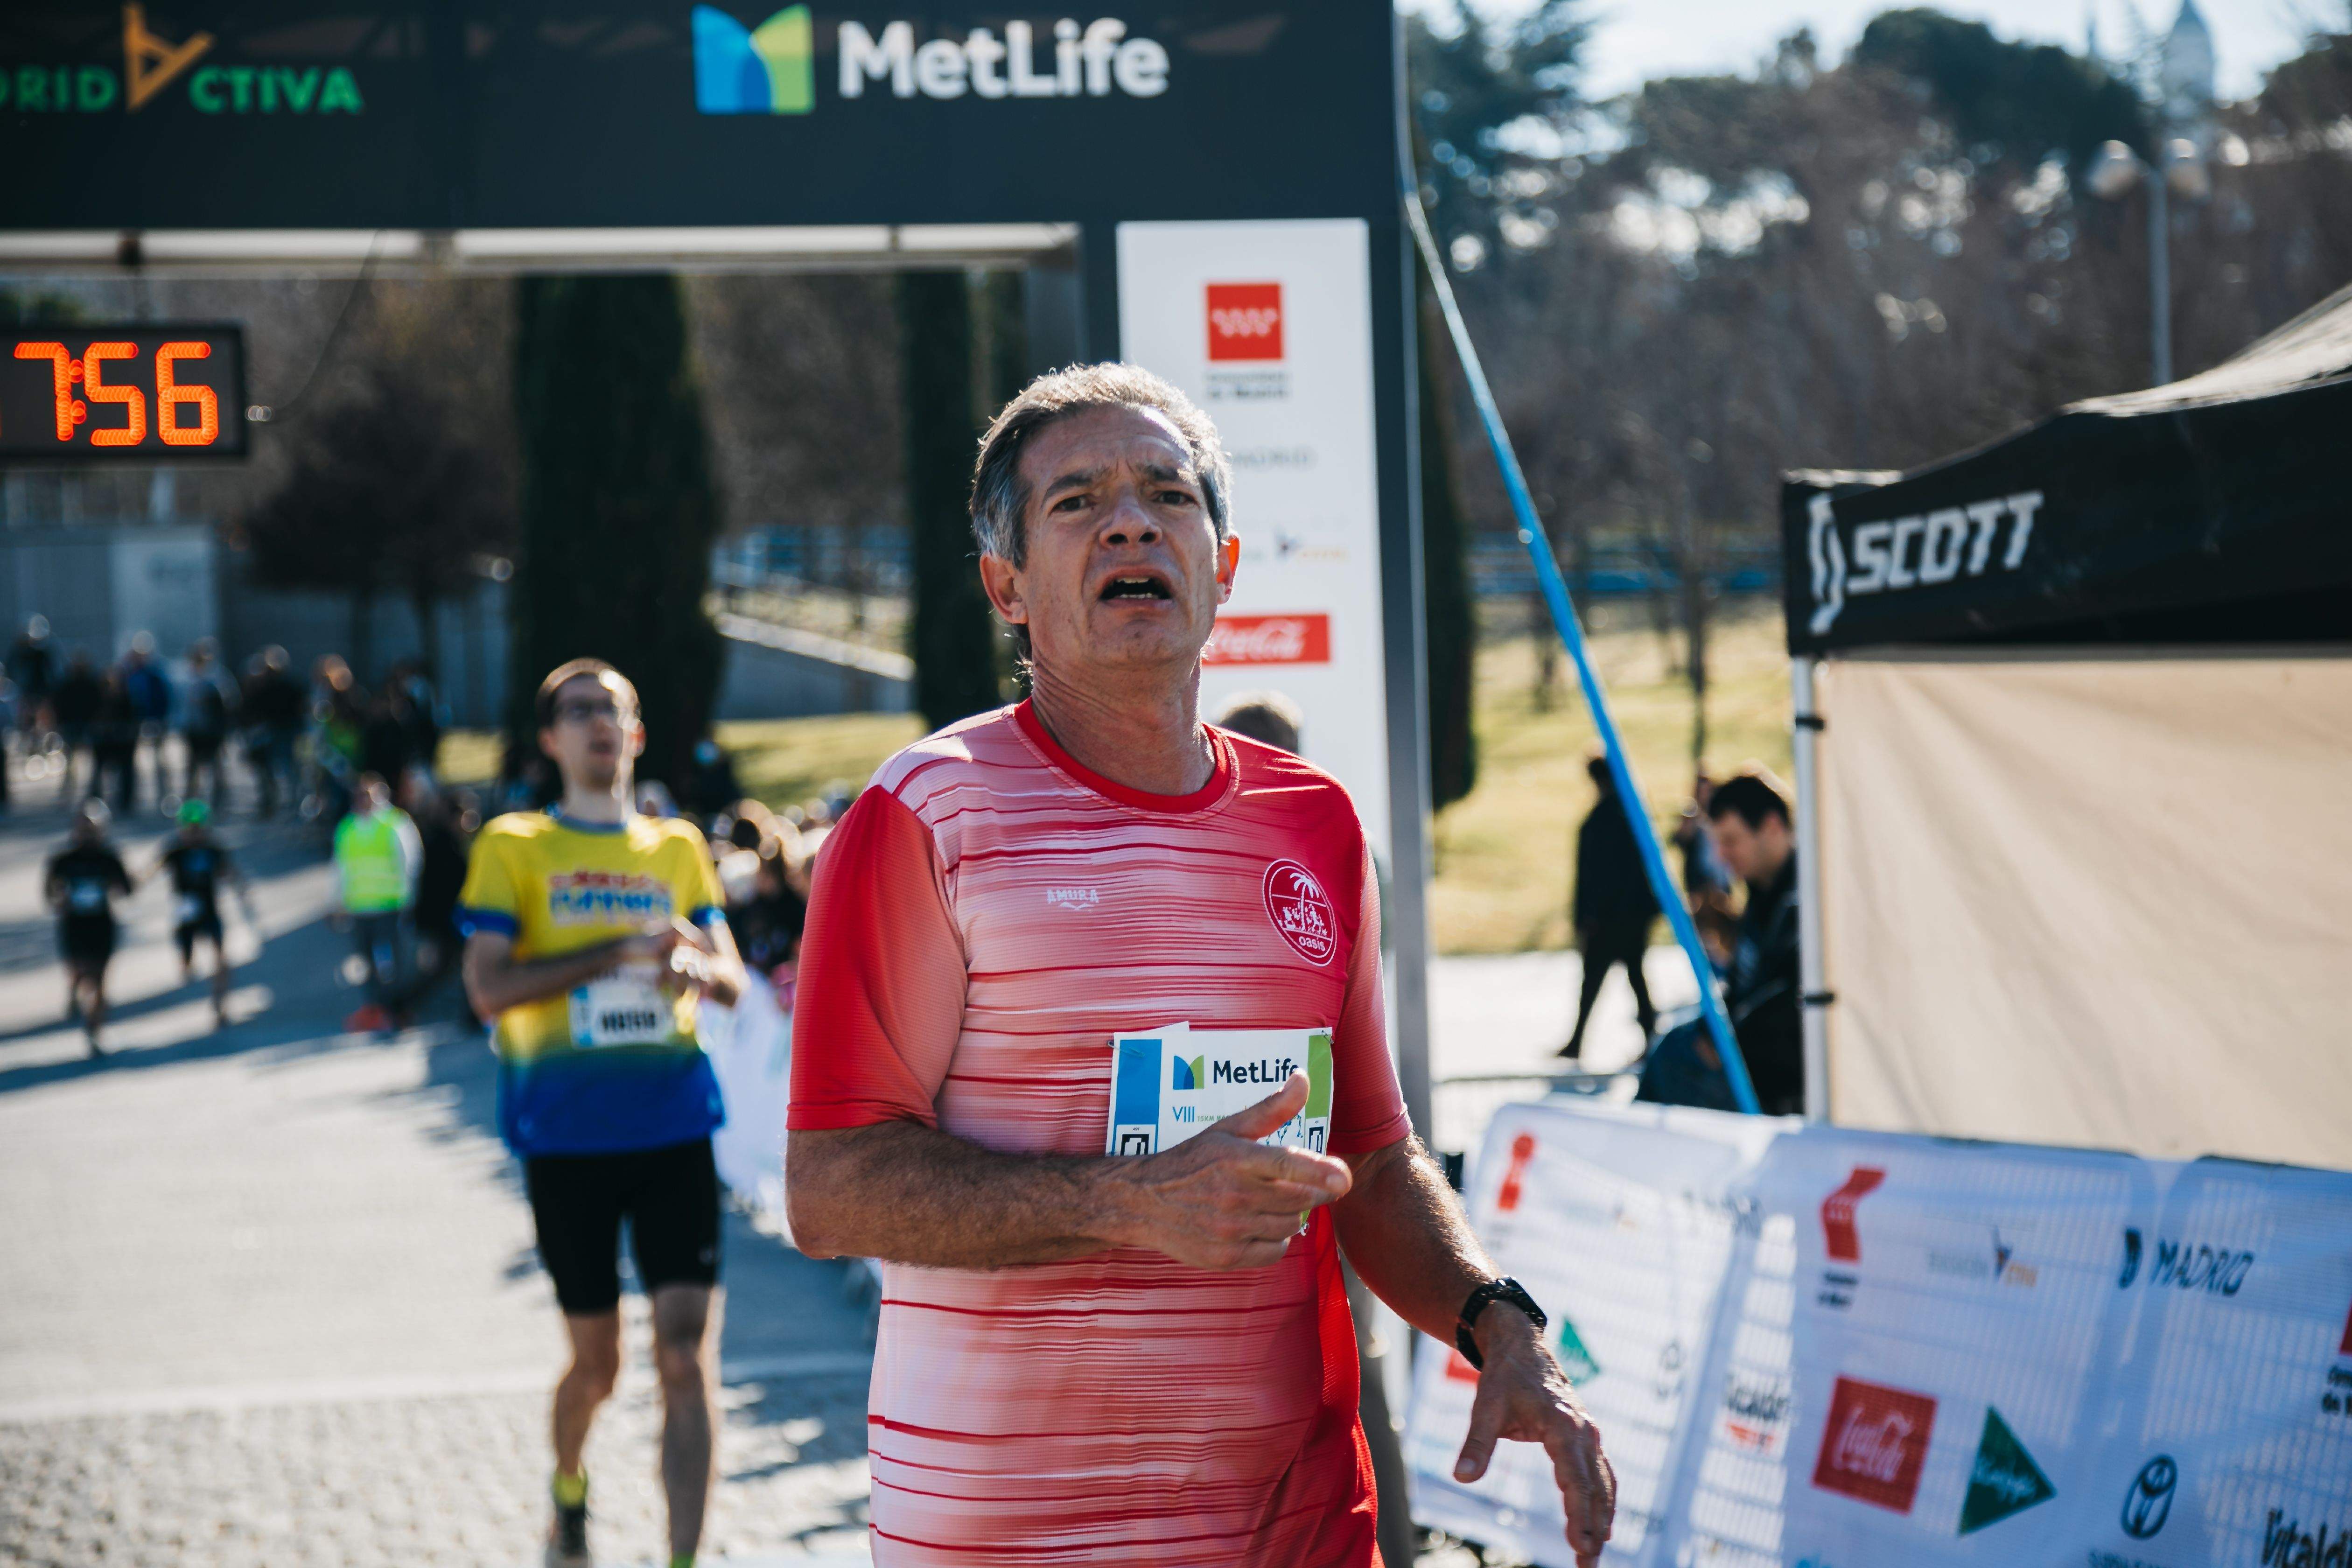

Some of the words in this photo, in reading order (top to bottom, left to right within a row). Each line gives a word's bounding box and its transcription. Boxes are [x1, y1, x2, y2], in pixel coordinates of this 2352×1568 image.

[839, 18, 1170, 98] MetLife
[14, 341, 219, 447] 7:56
[1846, 490, 2045, 595] SCOTT
[1047, 889, 1099, 903] AMURA
[1299, 936, 1325, 952] oasis
[1172, 1106, 1195, 1122] VIII
[2150, 1239, 2256, 1297] MADRID
